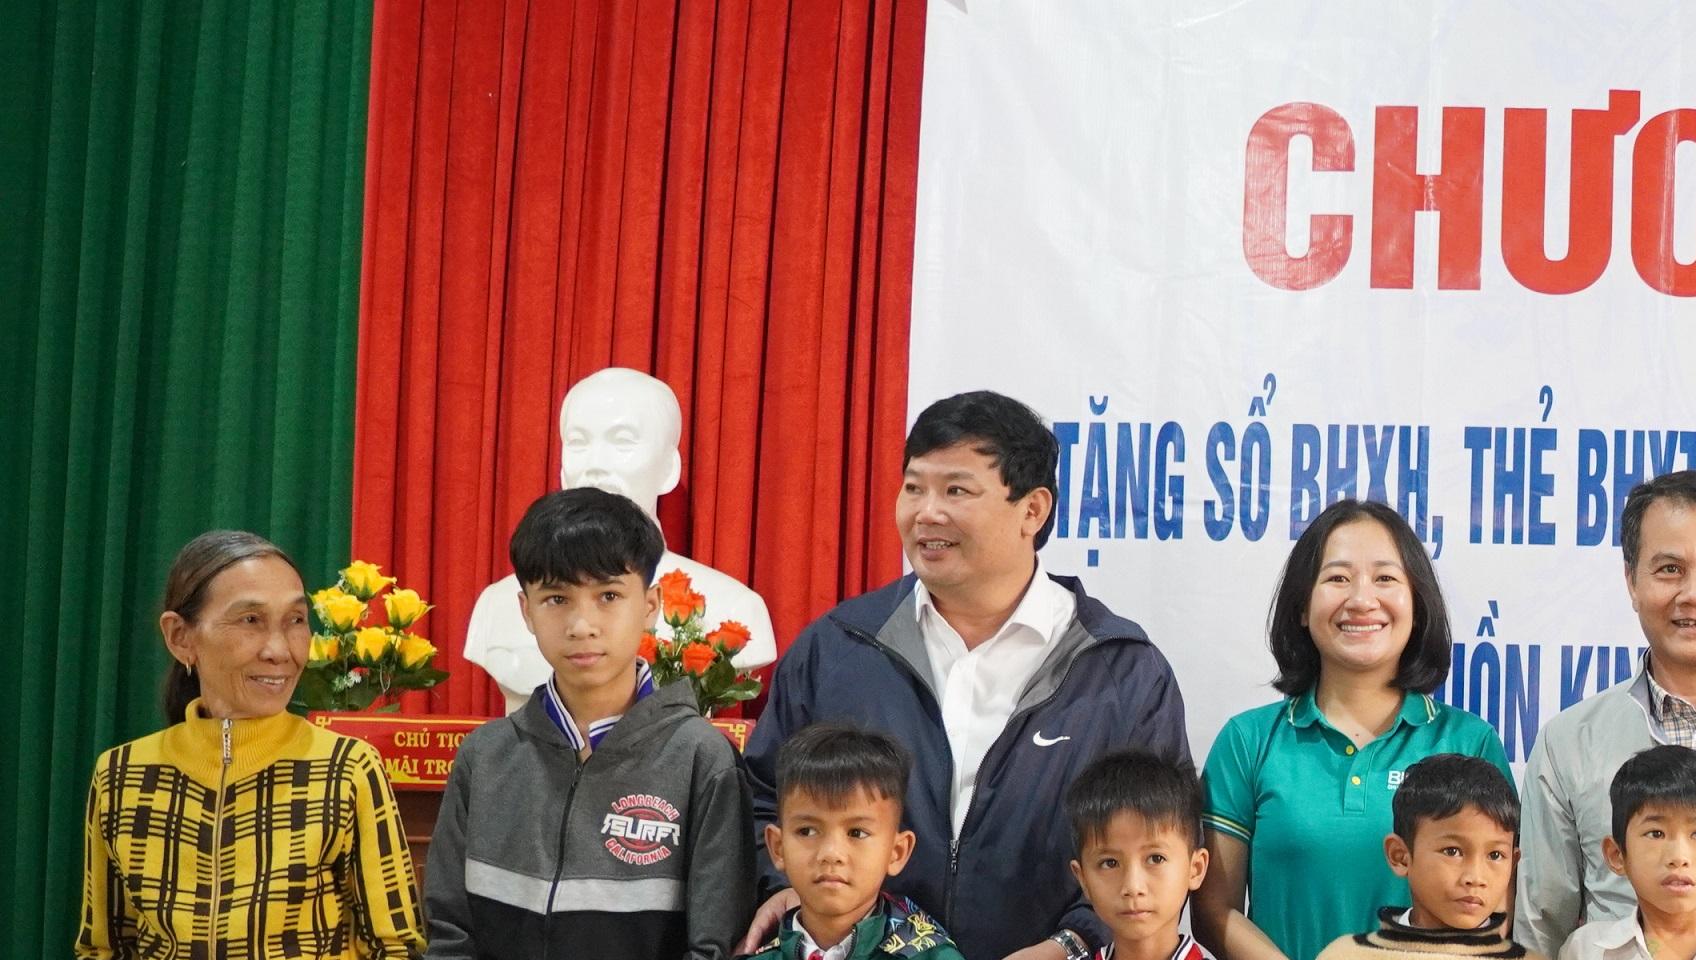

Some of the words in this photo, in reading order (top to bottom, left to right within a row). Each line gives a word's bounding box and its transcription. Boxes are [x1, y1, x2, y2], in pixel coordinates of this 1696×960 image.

[1052, 395, 1186, 567] TẶNG
[1203, 372, 1276, 542] SỔ
[1290, 422, 1444, 562] BHXH,
[1463, 384, 1558, 547] THẺ
[394, 727, 430, 748] CHỦ
[385, 755, 419, 775] MÃI
[604, 838, 672, 866] CALIFORNIA
